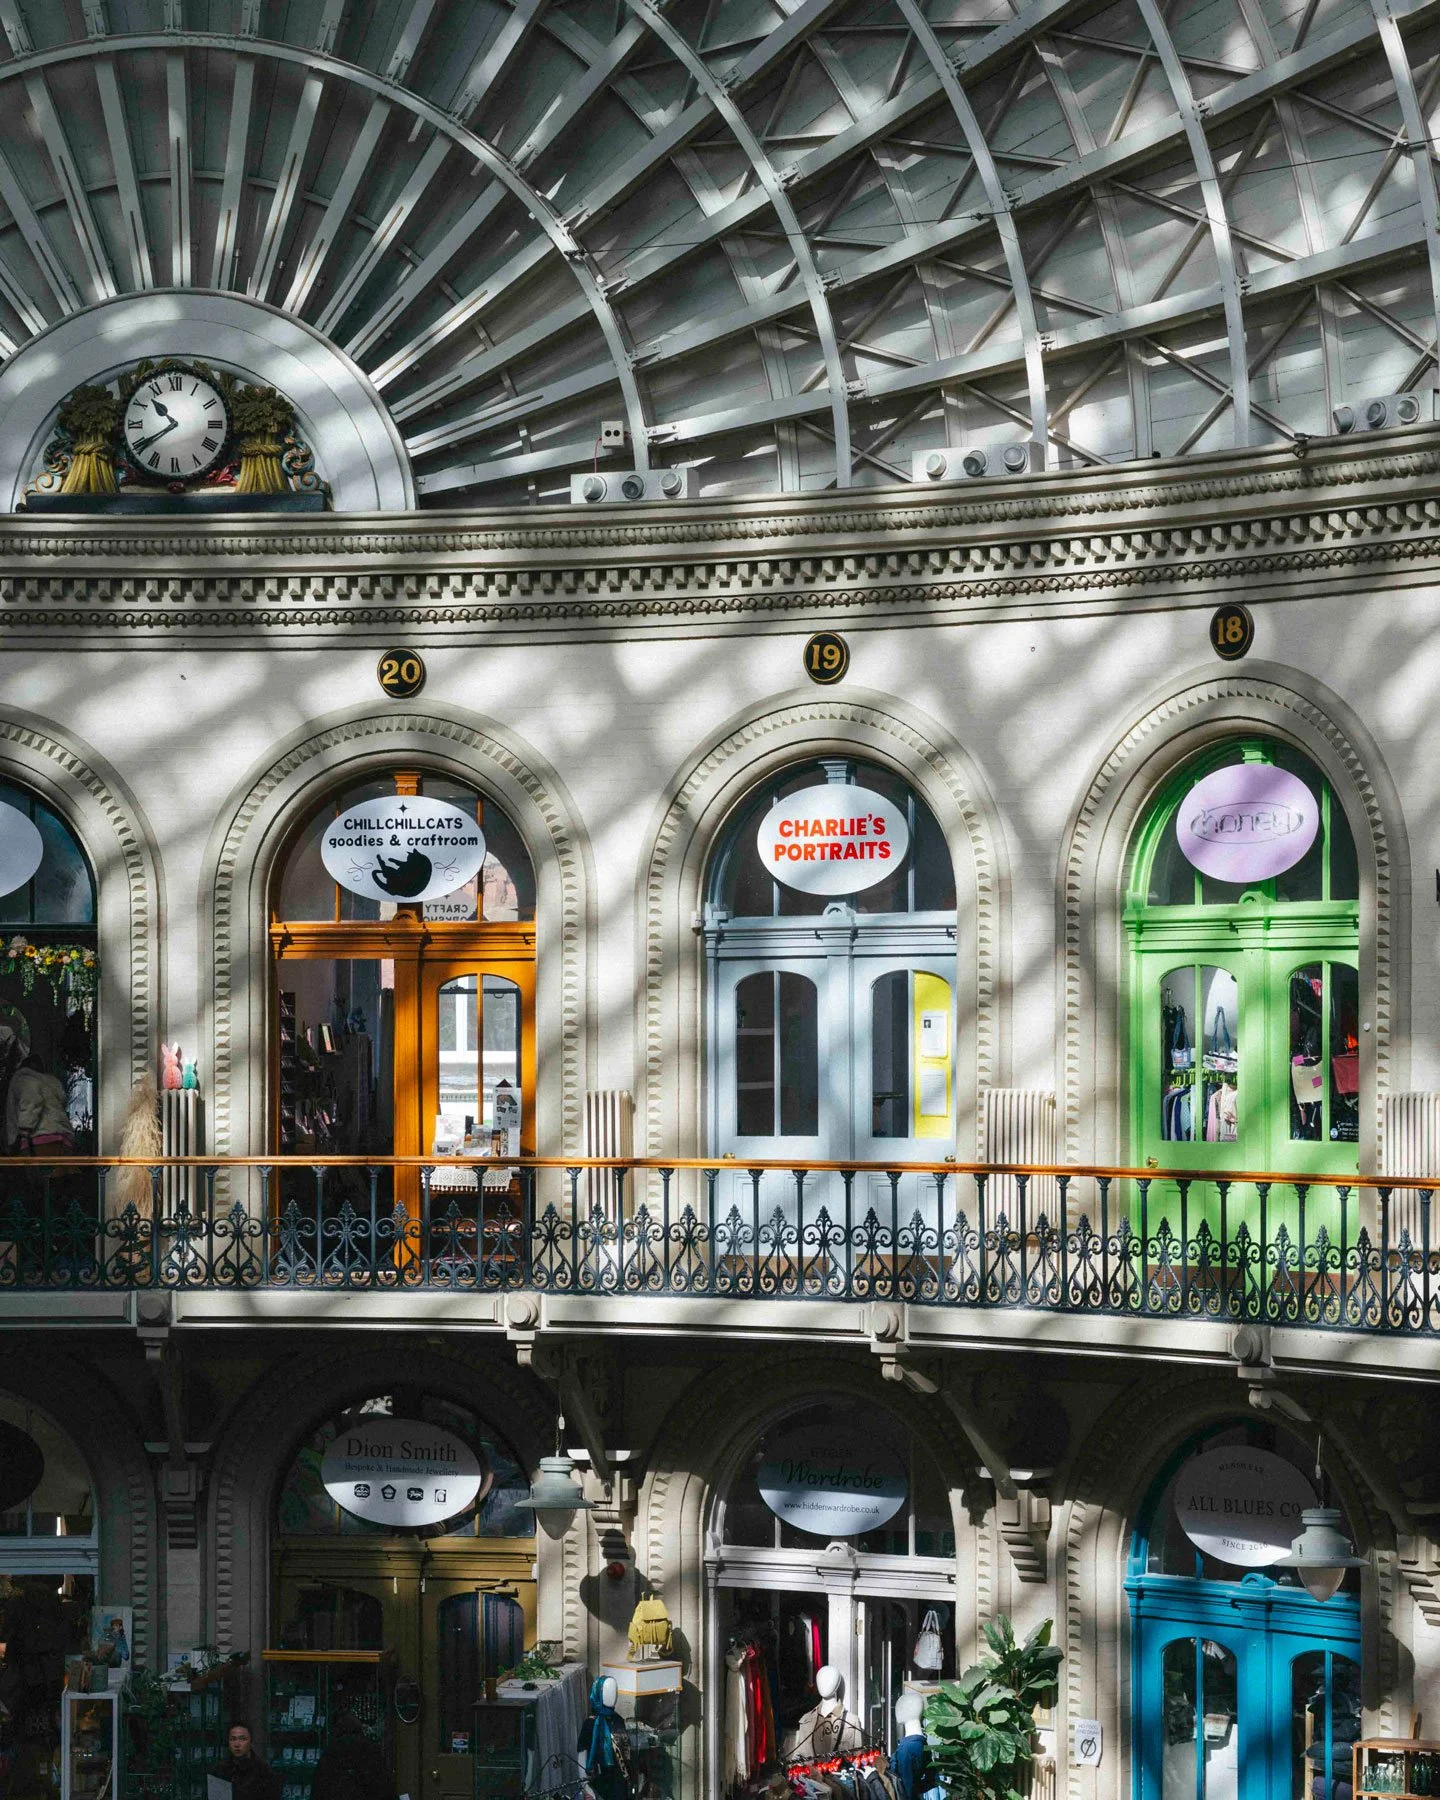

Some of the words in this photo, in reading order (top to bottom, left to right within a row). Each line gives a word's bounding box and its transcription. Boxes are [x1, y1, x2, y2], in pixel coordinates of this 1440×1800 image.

[168, 376, 182, 391] XII
[1217, 616, 1243, 645] 18
[811, 644, 840, 670] 19
[382, 659, 420, 685] 20
[343, 817, 463, 831] CHILLCHILLCATS
[779, 814, 886, 837] CHARLIE'S
[329, 835, 384, 849] goodies
[390, 834, 401, 847] &
[406, 833, 478, 847] craftroom
[774, 841, 891, 862] PORTRAITS
[346, 1438, 392, 1458] Dion
[400, 1440, 457, 1462] Smith
[345, 1462, 374, 1473] Bespoke
[376, 1464, 383, 1472] &
[386, 1464, 424, 1475] Handmade
[425, 1466, 459, 1477] Jewellery
[781, 1459, 883, 1489] Wardrobe
[783, 1501, 880, 1514] www.hiddenwardrobe.co.uk
[1188, 1496, 1218, 1512] ALL
[1224, 1498, 1274, 1516] BLUES
[1222, 1538, 1246, 1550] SINCE
